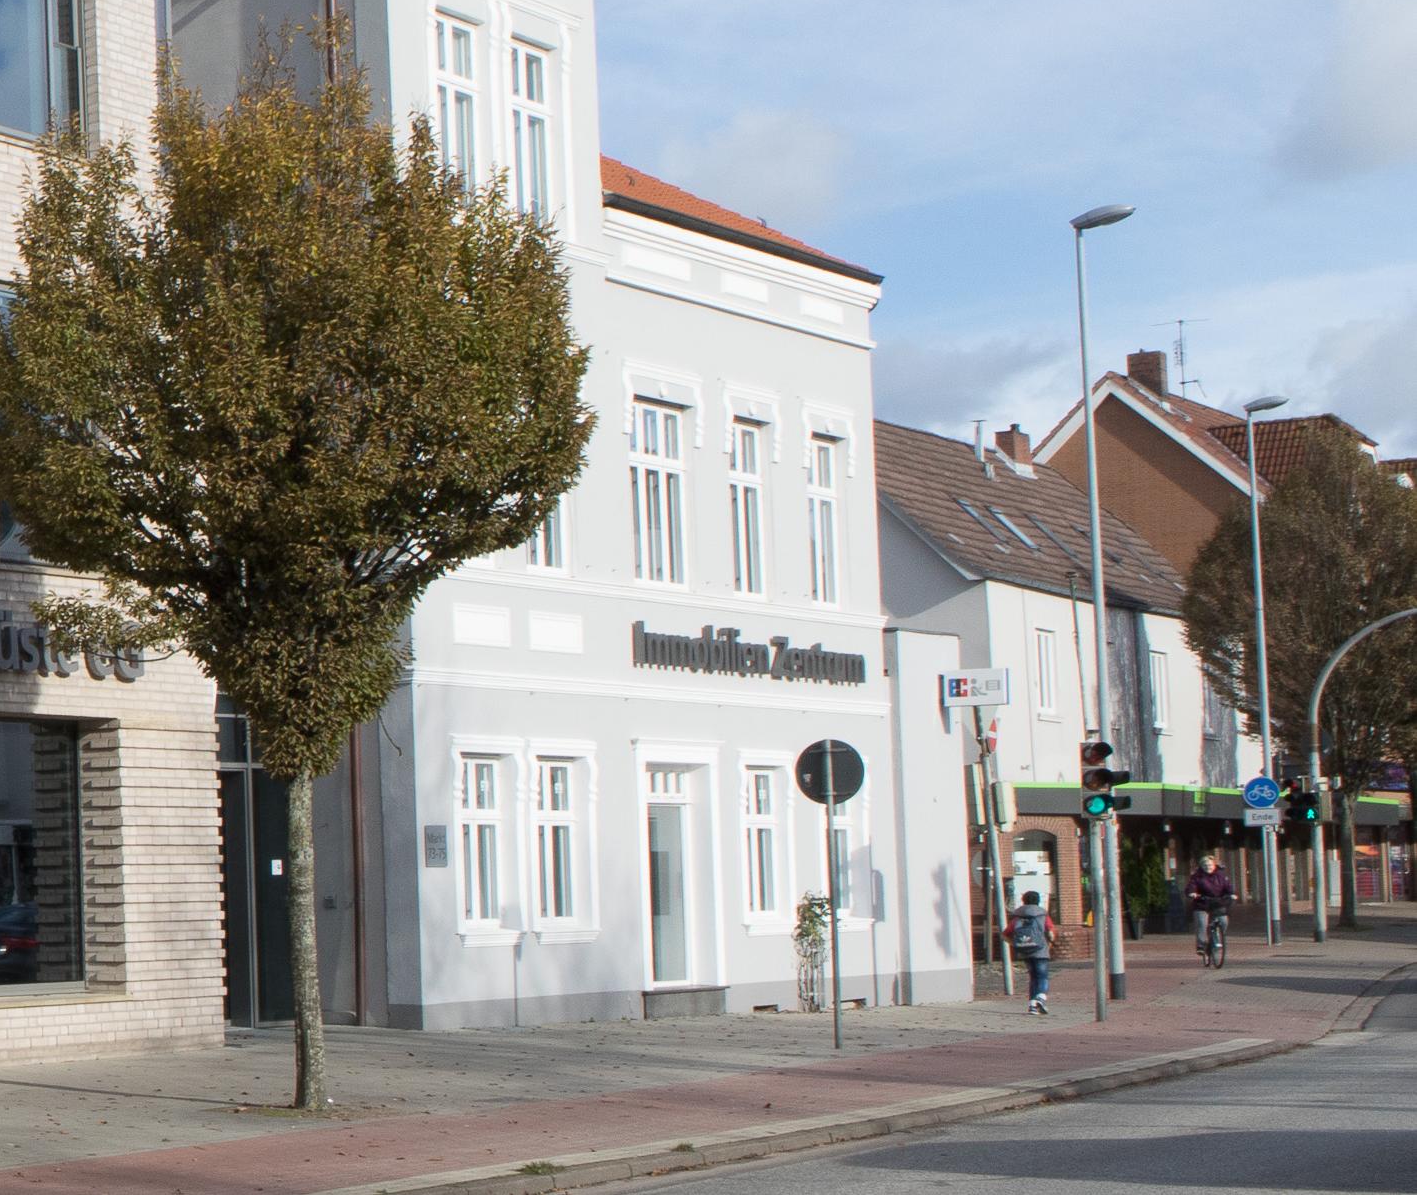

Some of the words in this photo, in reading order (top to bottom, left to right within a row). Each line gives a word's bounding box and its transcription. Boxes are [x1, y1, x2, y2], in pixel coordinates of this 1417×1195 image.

[632, 620, 769, 679] Immobilien
[769, 635, 866, 687] Zentrum
[1251, 813, 1274, 821] Ende
